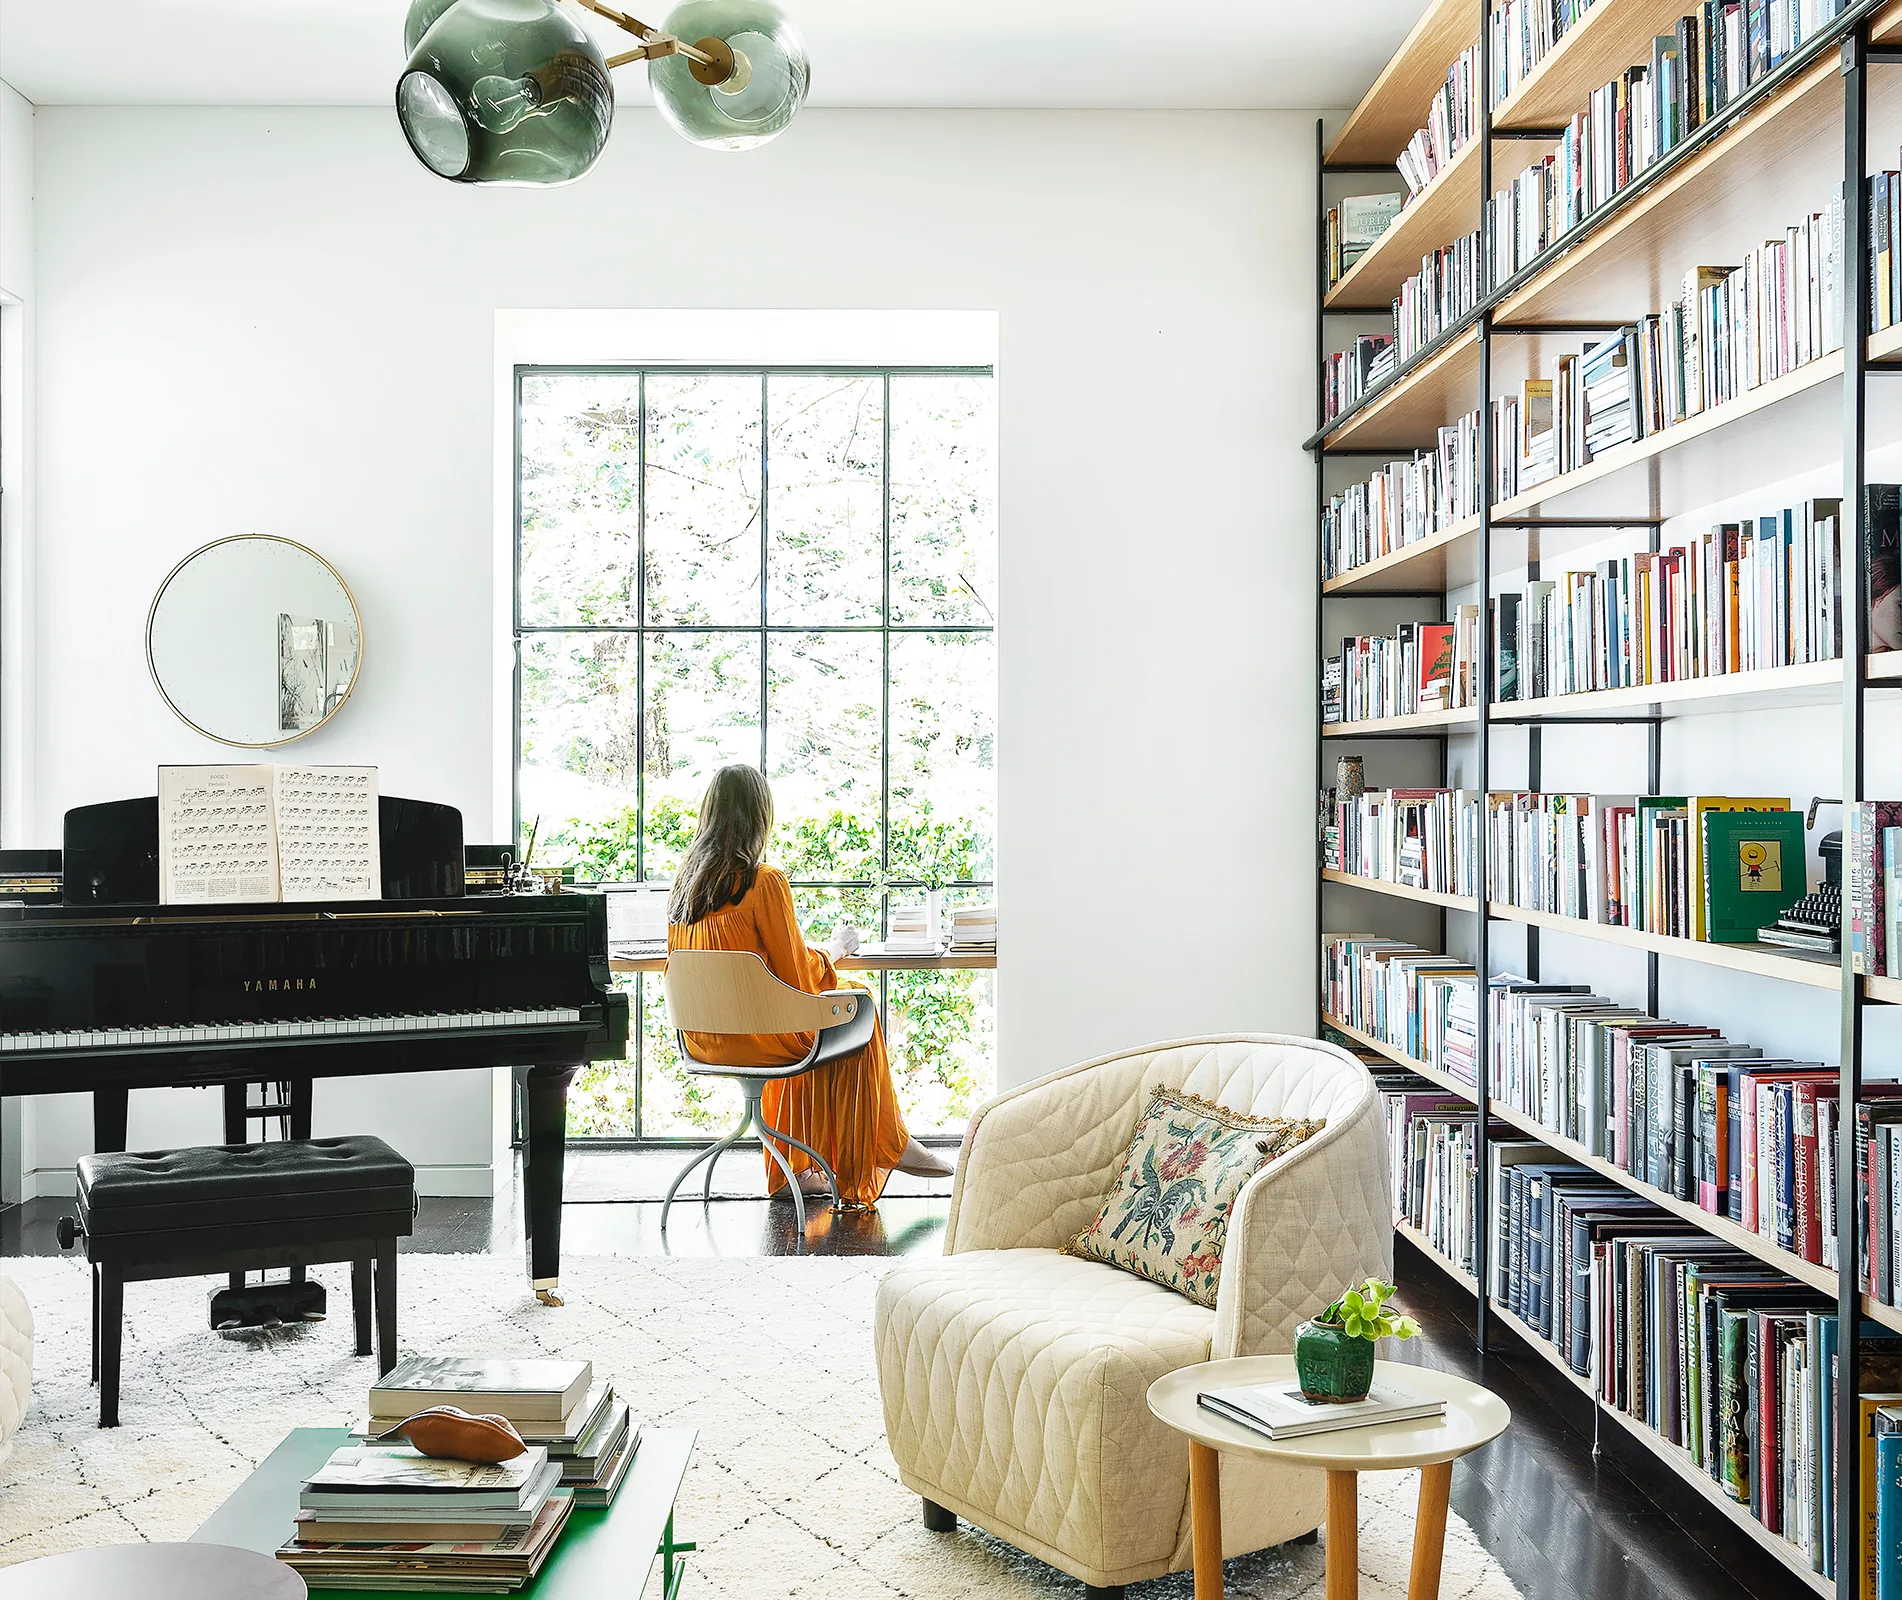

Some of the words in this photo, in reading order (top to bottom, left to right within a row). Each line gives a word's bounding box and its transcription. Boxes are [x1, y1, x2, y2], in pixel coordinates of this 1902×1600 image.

[1353, 216, 1390, 227] BURIA
[1832, 193, 1841, 265] ZEITOUN
[1862, 866, 1874, 923] SMITH
[243, 978, 317, 992] YAMAHA
[1650, 1054, 1659, 1135] MONASH
[1892, 1136, 1900, 1177] Oliver
[1799, 1145, 1807, 1234] DICTIONARY
[1892, 1179, 1900, 1217] Sacks
[1893, 1229, 1901, 1288] HALLUCINATIONS
[1687, 1303, 1696, 1368] BRITAIN
[1749, 1329, 1758, 1379] TIME
[1808, 1448, 1818, 1522] WILDERNESS
[491, 1523, 531, 1552] ORKER
